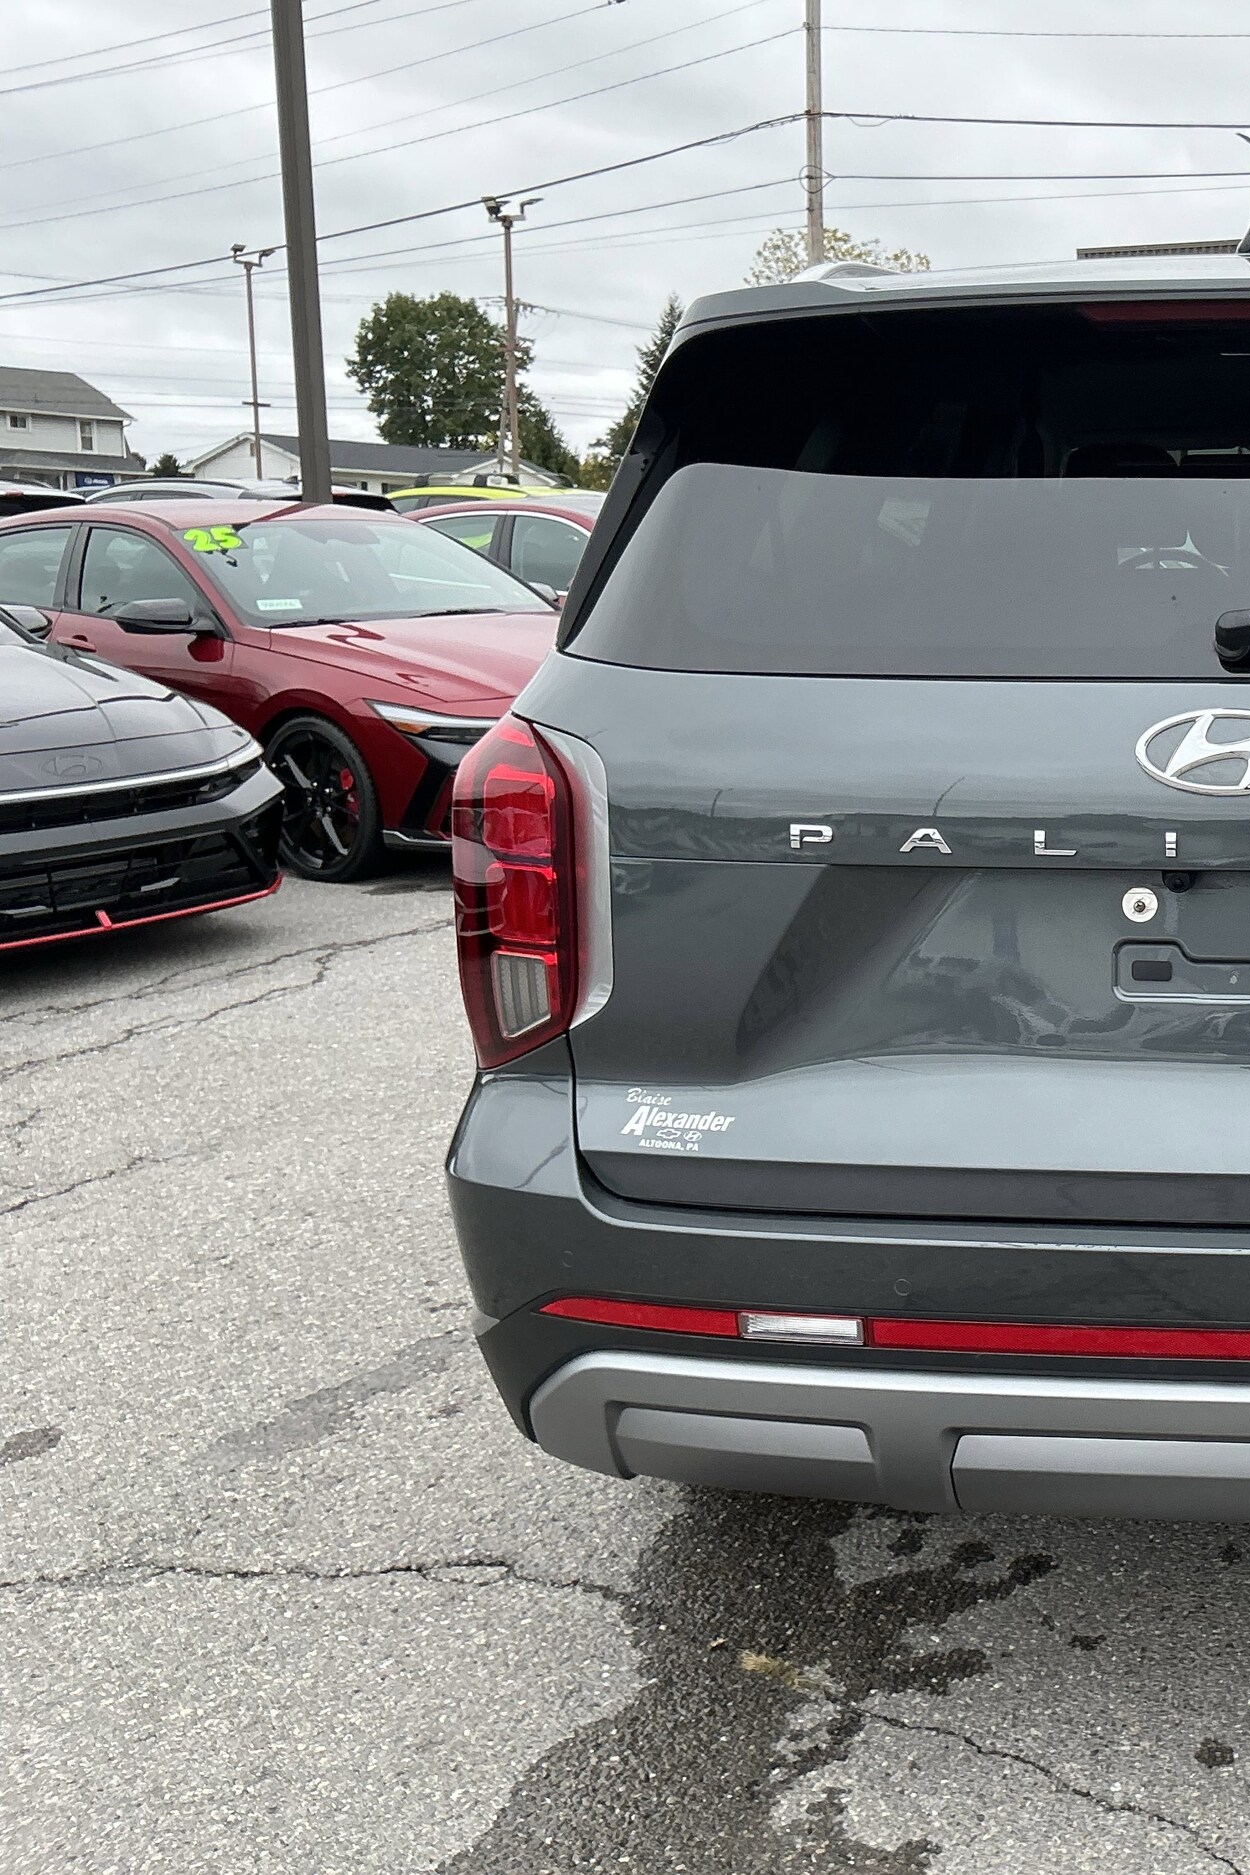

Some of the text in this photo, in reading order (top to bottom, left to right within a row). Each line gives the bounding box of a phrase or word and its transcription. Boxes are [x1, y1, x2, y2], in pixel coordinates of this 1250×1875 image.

[183, 524, 242, 552] 25
[626, 1087, 672, 1106] Blaise
[620, 1105, 736, 1136] Alexander
[686, 1143, 699, 1151] PA
